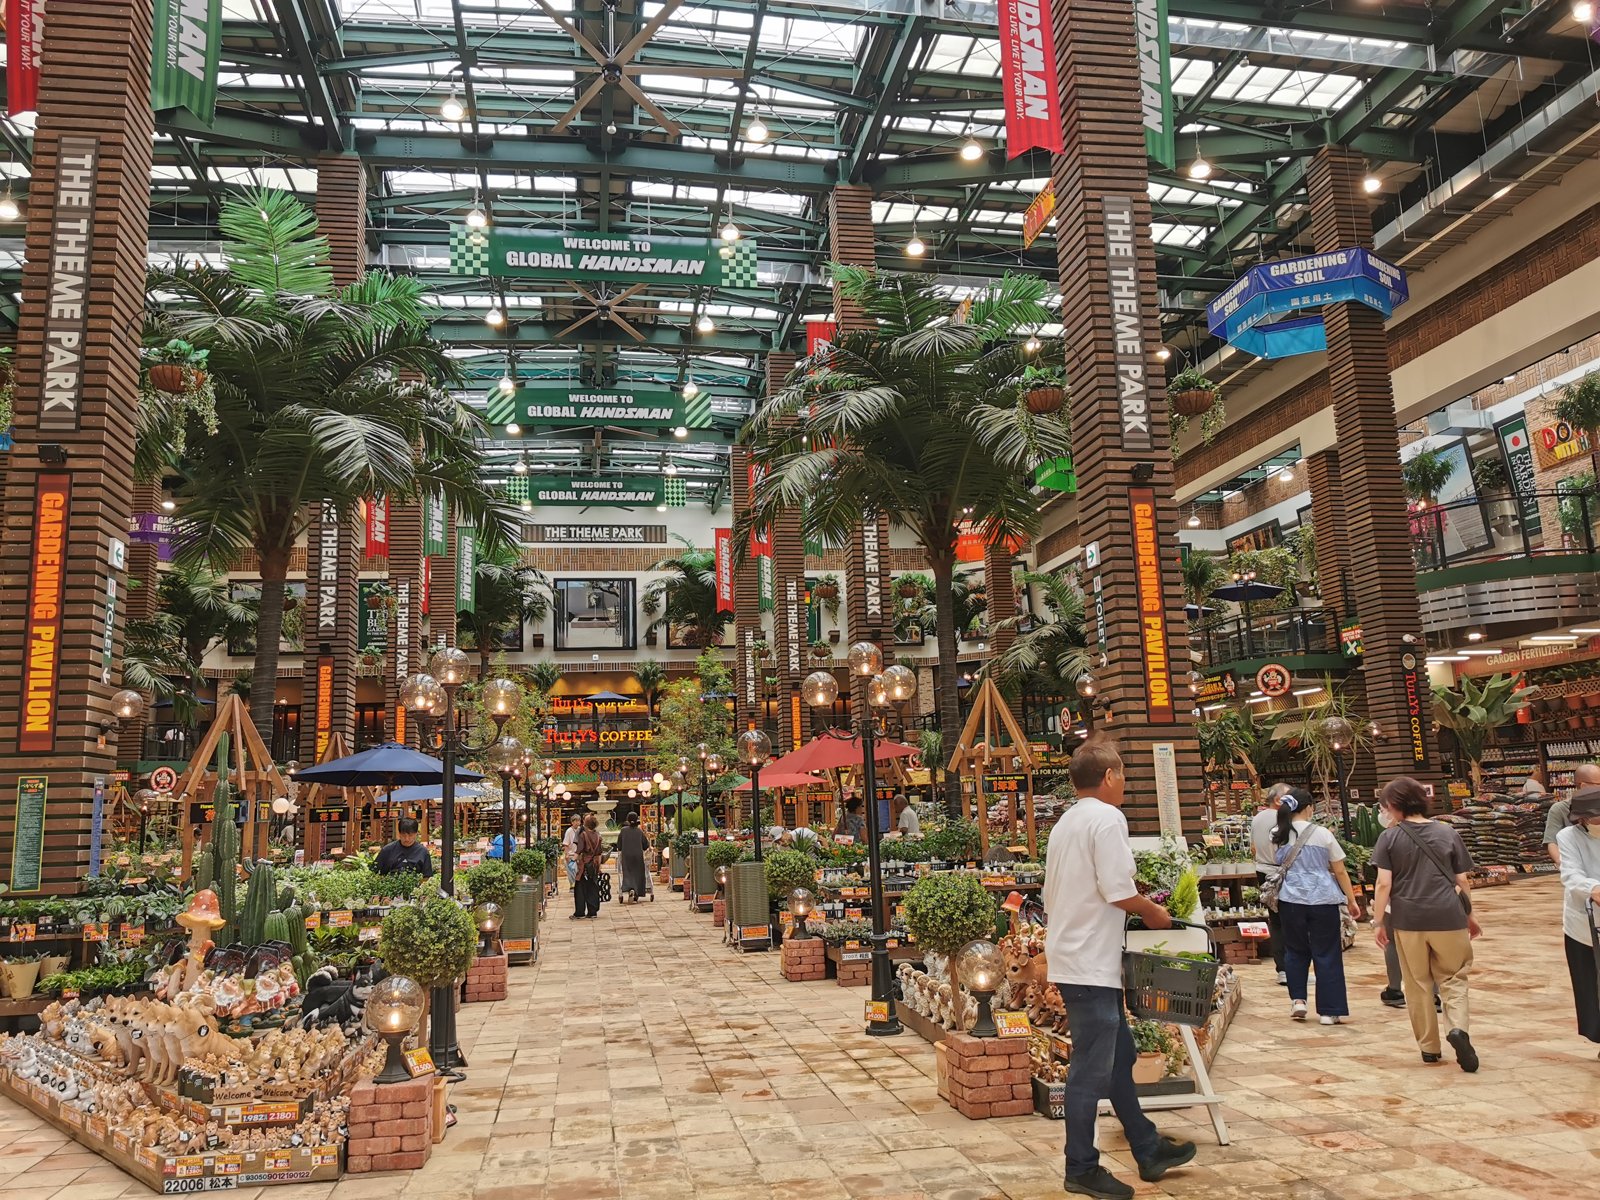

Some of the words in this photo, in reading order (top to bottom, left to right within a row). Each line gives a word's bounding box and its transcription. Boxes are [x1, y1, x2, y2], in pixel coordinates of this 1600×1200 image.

[19, 14, 31, 42] YOUR
[167, 15, 178, 44] YOUR
[21, 43, 31, 70] WAY.
[165, 44, 177, 69] WAY.
[1010, 40, 1019, 59] LIVE
[1013, 71, 1023, 97] YOUR
[59, 153, 93, 206] THE
[563, 237, 631, 251] WELCOME
[633, 240, 651, 253] TO
[1106, 210, 1134, 258] THE
[50, 220, 89, 320] THEME
[506, 251, 574, 270] GLOBAL
[577, 256, 705, 275] HANDSMAN
[1270, 253, 1347, 277] GARDENING
[1294, 269, 1325, 285] SOIL
[1367, 254, 1401, 281] GARDENING
[1379, 271, 1393, 288] SOIL
[1212, 275, 1250, 314] GARDENING
[1224, 297, 1240, 317] SOIL
[1111, 267, 1143, 355] THEME
[42, 330, 80, 412] PARK
[527, 405, 577, 418] GLOBAL
[580, 406, 673, 420] HANDSMAN
[569, 394, 617, 403] WELCOME
[620, 394, 633, 404] TO
[1117, 364, 1149, 434] PARK
[538, 490, 578, 501] GLOBAL
[580, 491, 655, 502] HANDSMAN
[571, 481, 611, 489] WELCOME
[612, 481, 623, 489] TO
[544, 527, 567, 538] THE
[569, 527, 610, 538] THEME
[612, 527, 643, 538] PARK
[33, 492, 65, 620] GARDENING
[321, 528, 338, 581] THEME
[863, 525, 880, 573] THEME
[1134, 503, 1161, 612] GARDENING
[398, 582, 409, 604] THE
[787, 581, 797, 600] THE
[866, 578, 881, 616] PARK
[319, 586, 337, 628] PARK
[1094, 595, 1106, 645] TOILET
[103, 601, 116, 658] TOILET
[397, 606, 409, 645] THEME
[787, 605, 799, 640] THEME
[745, 630, 754, 648] THE
[396, 648, 408, 679] PARK
[789, 643, 800, 671] PARK
[1144, 616, 1169, 706] PAVILION
[1486, 650, 1520, 666] GARDEN
[26, 625, 56, 732] PAVILION
[746, 681, 755, 704] PARK
[318, 665, 331, 729] GARDENING
[1405, 671, 1421, 716] TULLY'S
[543, 729, 597, 743] TULLY'S
[600, 730, 653, 742] COFFEE
[1410, 717, 1424, 761] COFFEE
[215, 1091, 252, 1100] Welcome
[165, 1178, 204, 1193] 22006
[209, 1177, 233, 1189] 松本
